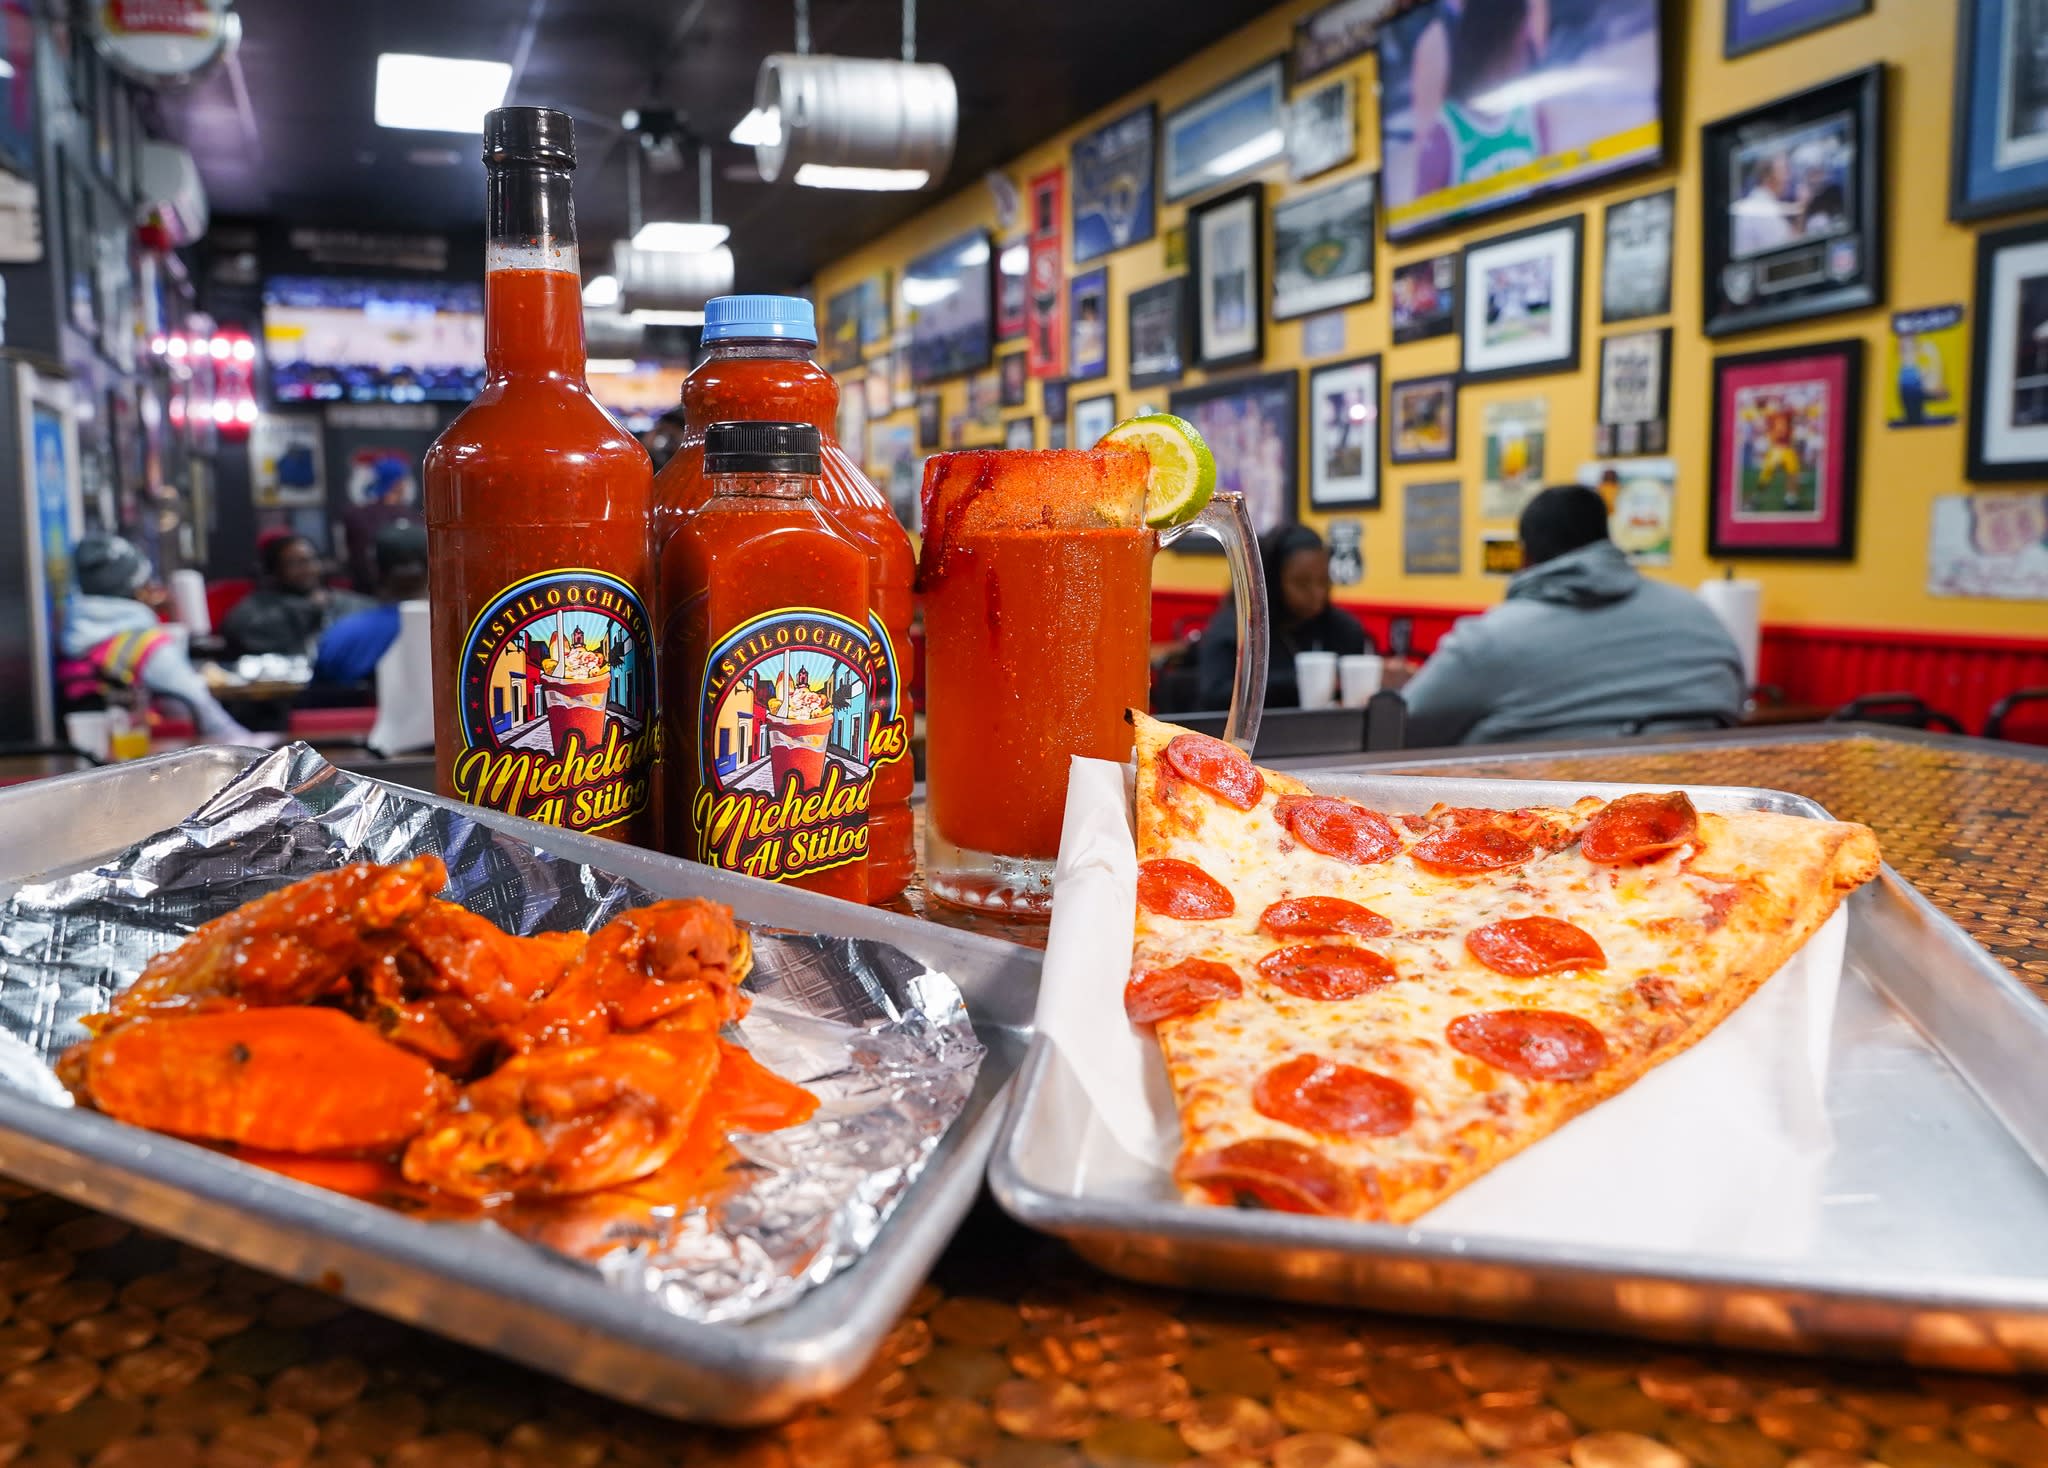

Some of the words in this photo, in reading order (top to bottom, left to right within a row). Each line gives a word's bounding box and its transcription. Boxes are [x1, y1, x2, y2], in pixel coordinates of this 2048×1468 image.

[527, 799, 563, 827] Al
[744, 838, 779, 877] Al
[786, 824, 869, 868] Stiloo
